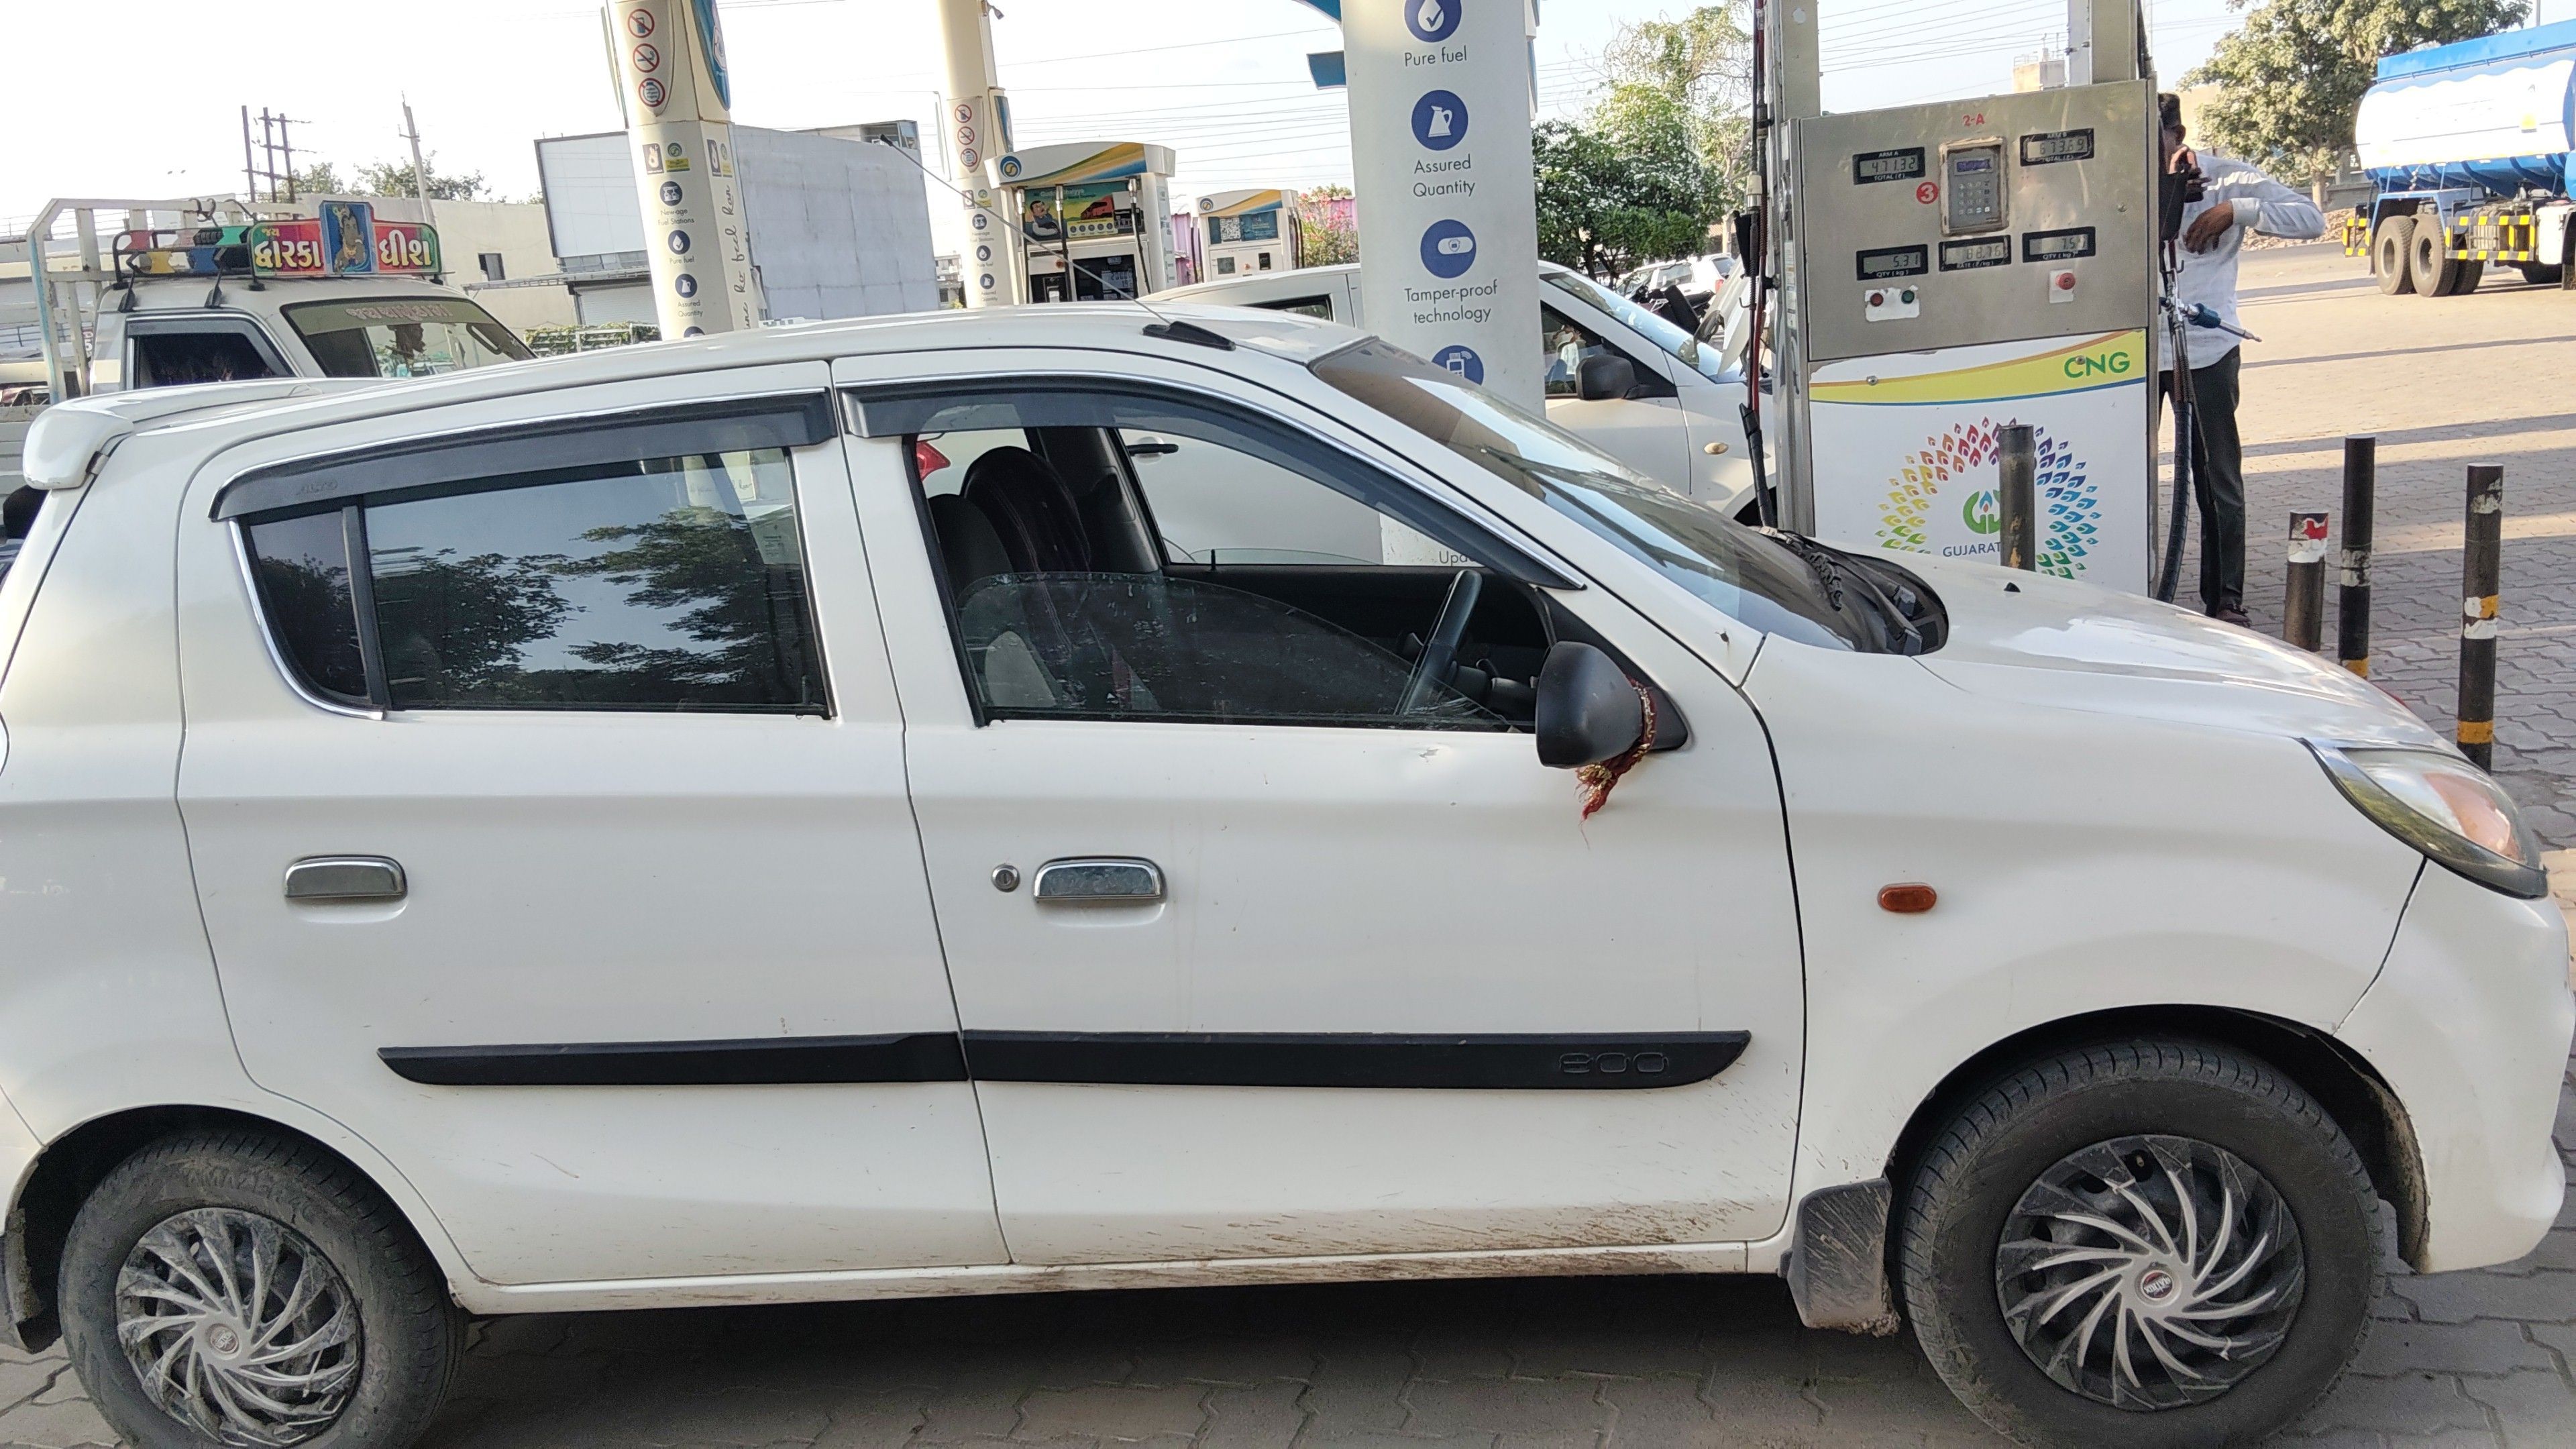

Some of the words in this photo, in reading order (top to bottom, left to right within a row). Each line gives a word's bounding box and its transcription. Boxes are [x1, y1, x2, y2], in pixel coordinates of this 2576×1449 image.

[1405, 52, 1436, 66] Pure
[1442, 45, 1467, 62] fuel
[1963, 113, 1985, 127] 2-A
[1414, 154, 1470, 174] Assured
[1872, 157, 1916, 173] 471.32
[1413, 180, 1475, 197] Quantity
[1921, 183, 1935, 202] 3
[725, 225, 745, 262] feel
[254, 240, 324, 268] દ્વારકા
[1893, 254, 1918, 267] 5.31
[1404, 278, 1497, 304] Tamper-proof
[678, 309, 703, 317] Quantity
[1414, 305, 1491, 324] technology
[2064, 352, 2130, 378] CNG
[1943, 542, 2001, 557] GUJARAT
[1560, 1053, 1668, 1073] 800
